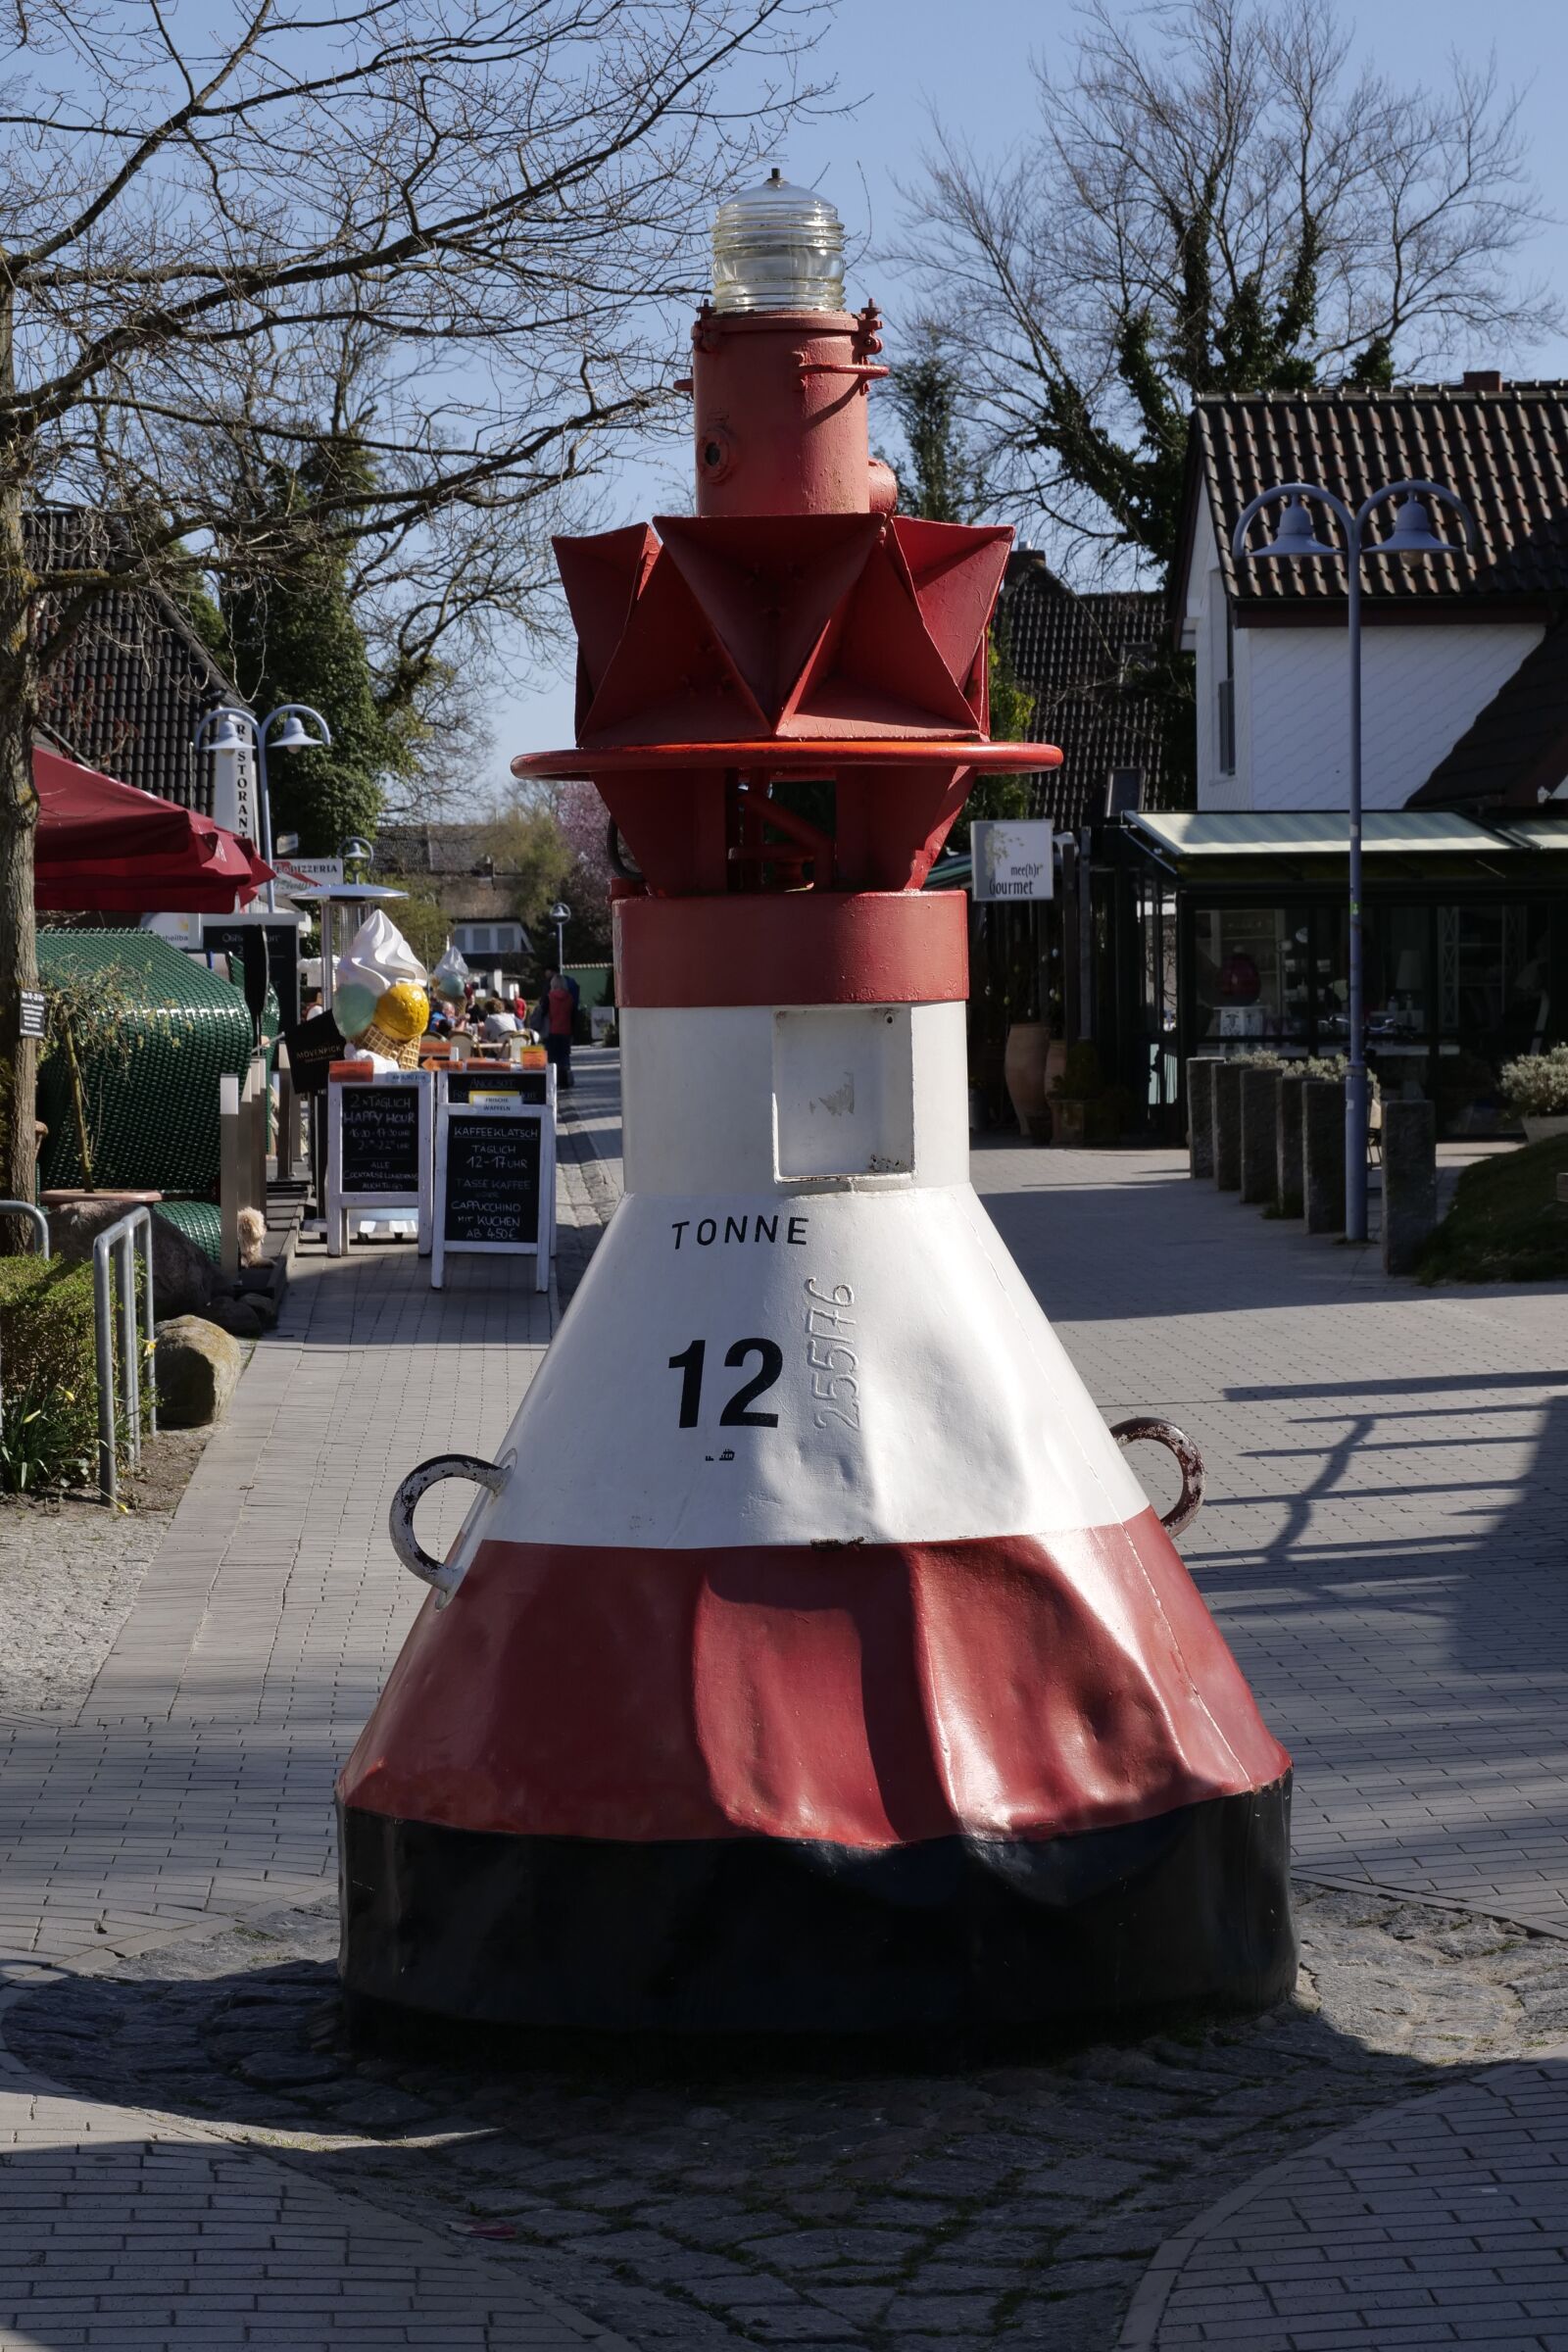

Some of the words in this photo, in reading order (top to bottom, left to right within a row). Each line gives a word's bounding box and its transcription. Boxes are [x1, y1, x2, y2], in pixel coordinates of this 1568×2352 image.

[989, 878, 1034, 896] Gourmet
[343, 1110, 382, 1126] HAPPY
[385, 1111, 416, 1124] HOUR
[454, 1126, 538, 1138] KAFFEEKLATSCH
[508, 1159, 528, 1169] UHR
[455, 1178, 488, 1189] TASSE
[492, 1179, 532, 1190] KAFFEE
[477, 1214, 521, 1228] KUCHEN
[466, 1229, 482, 1239] AB
[671, 1215, 809, 1250] TONNE
[668, 1337, 783, 1429] 12
